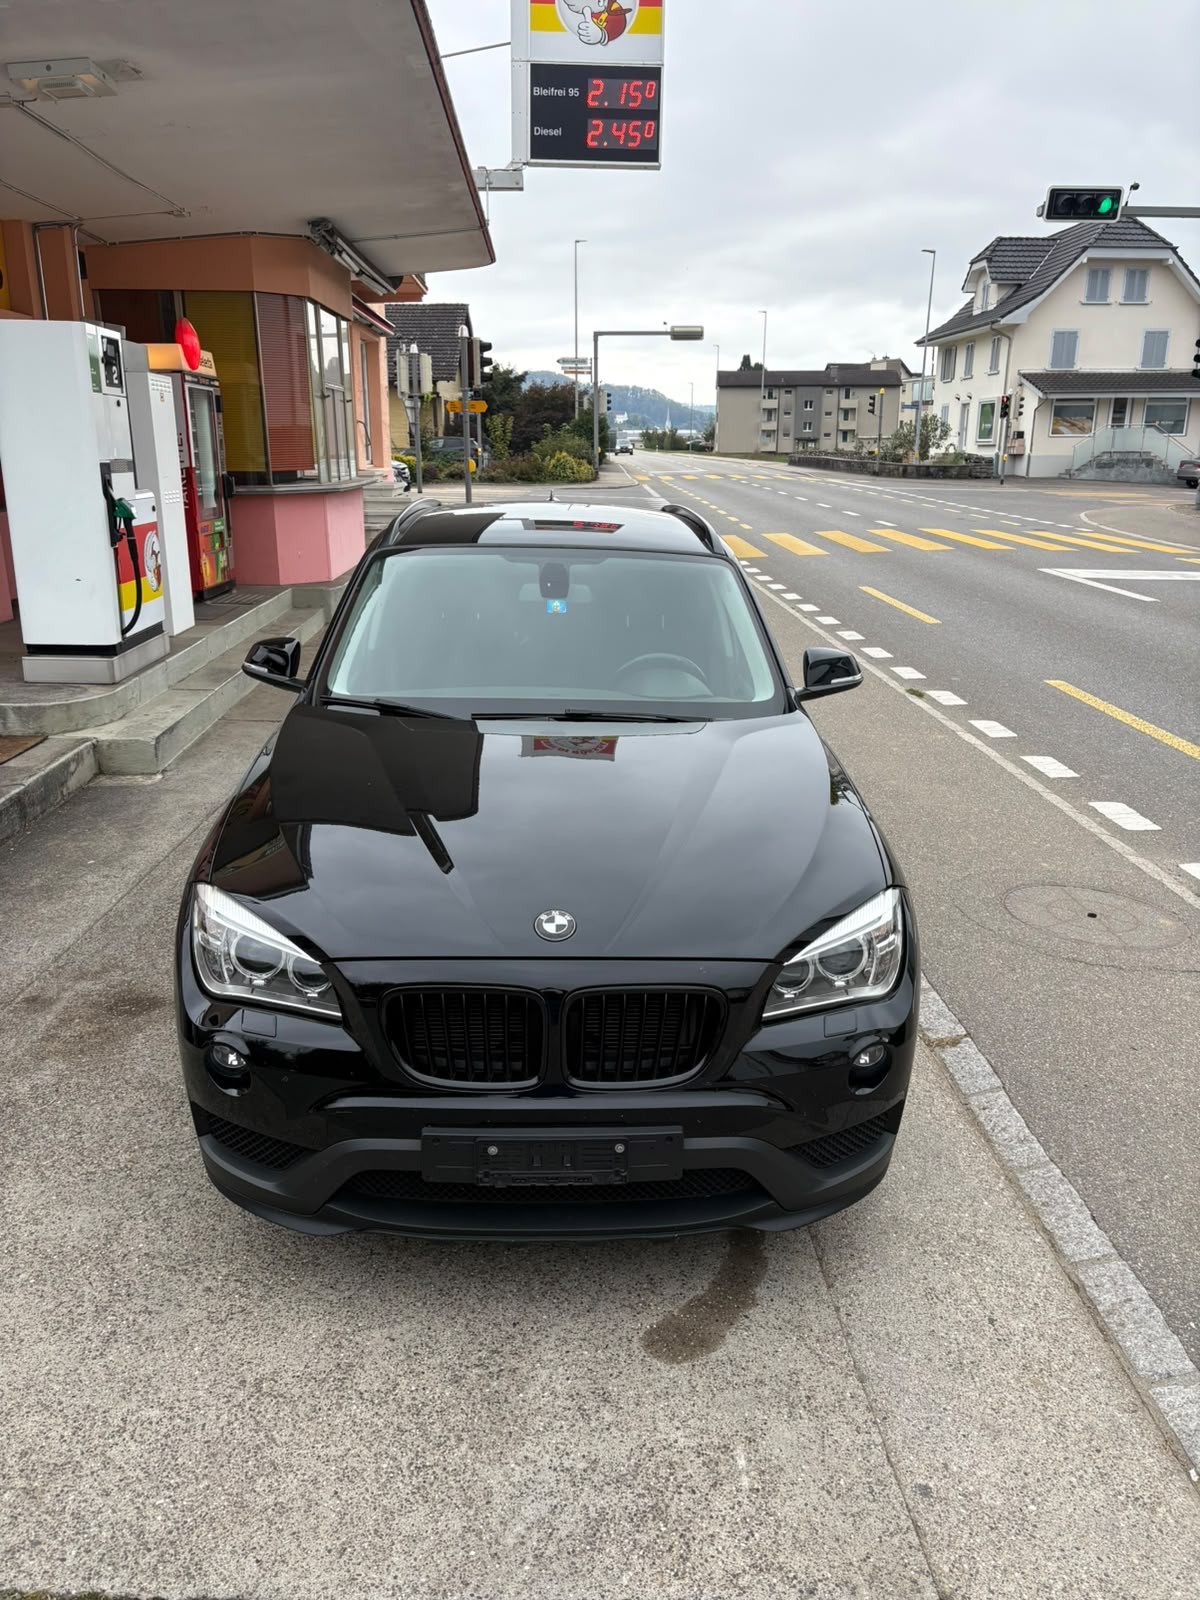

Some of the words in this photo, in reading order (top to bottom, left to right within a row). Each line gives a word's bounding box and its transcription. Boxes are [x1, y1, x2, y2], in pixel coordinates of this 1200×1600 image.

[533, 86, 566, 97] Bleifrei
[568, 87, 580, 97] 95
[586, 79, 656, 108] 2.150
[533, 126, 562, 136] Diesel
[586, 119, 655, 147] 2.450
[112, 366, 118, 384] 2
